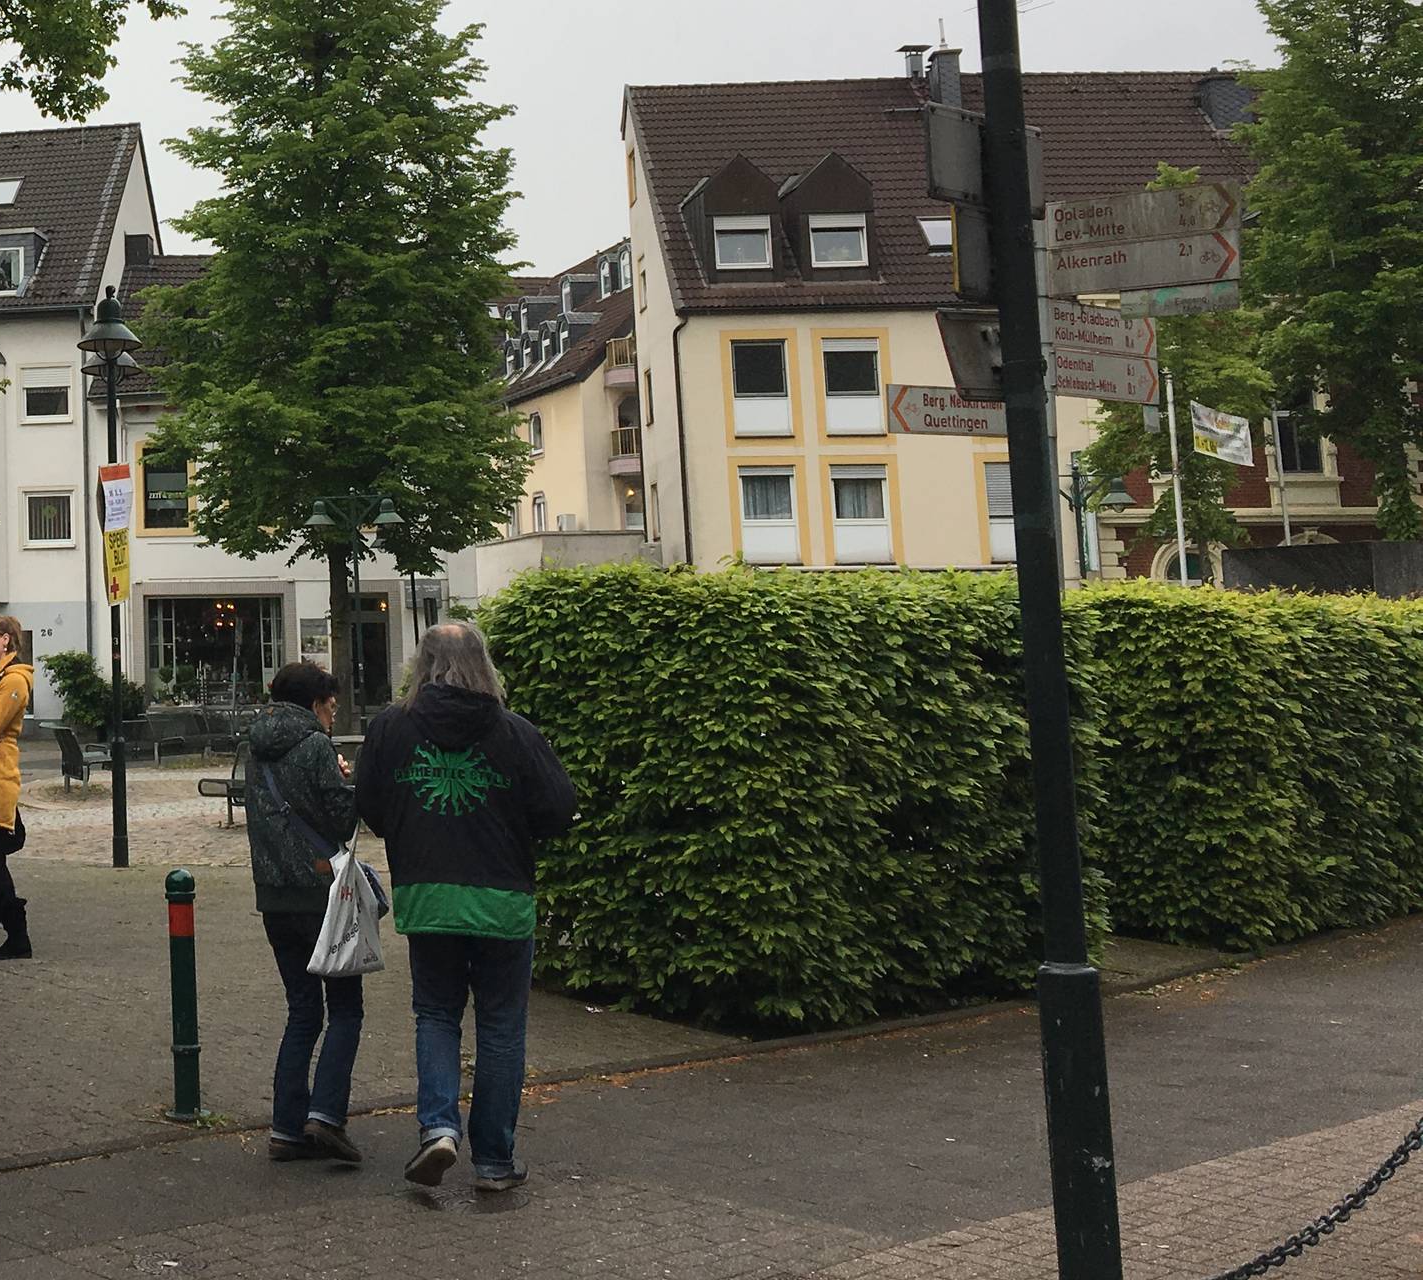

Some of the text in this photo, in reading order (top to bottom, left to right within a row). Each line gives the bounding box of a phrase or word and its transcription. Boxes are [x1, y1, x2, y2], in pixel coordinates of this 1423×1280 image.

[1054, 205, 1113, 224] Opladen
[1055, 223, 1125, 242] Lev.-Mitte
[1057, 250, 1127, 270] Alkenrath
[1057, 356, 1095, 372] Odenthal
[923, 393, 947, 411] Berg.
[924, 414, 988, 432] Quettingen
[40, 629, 53, 637] 26
